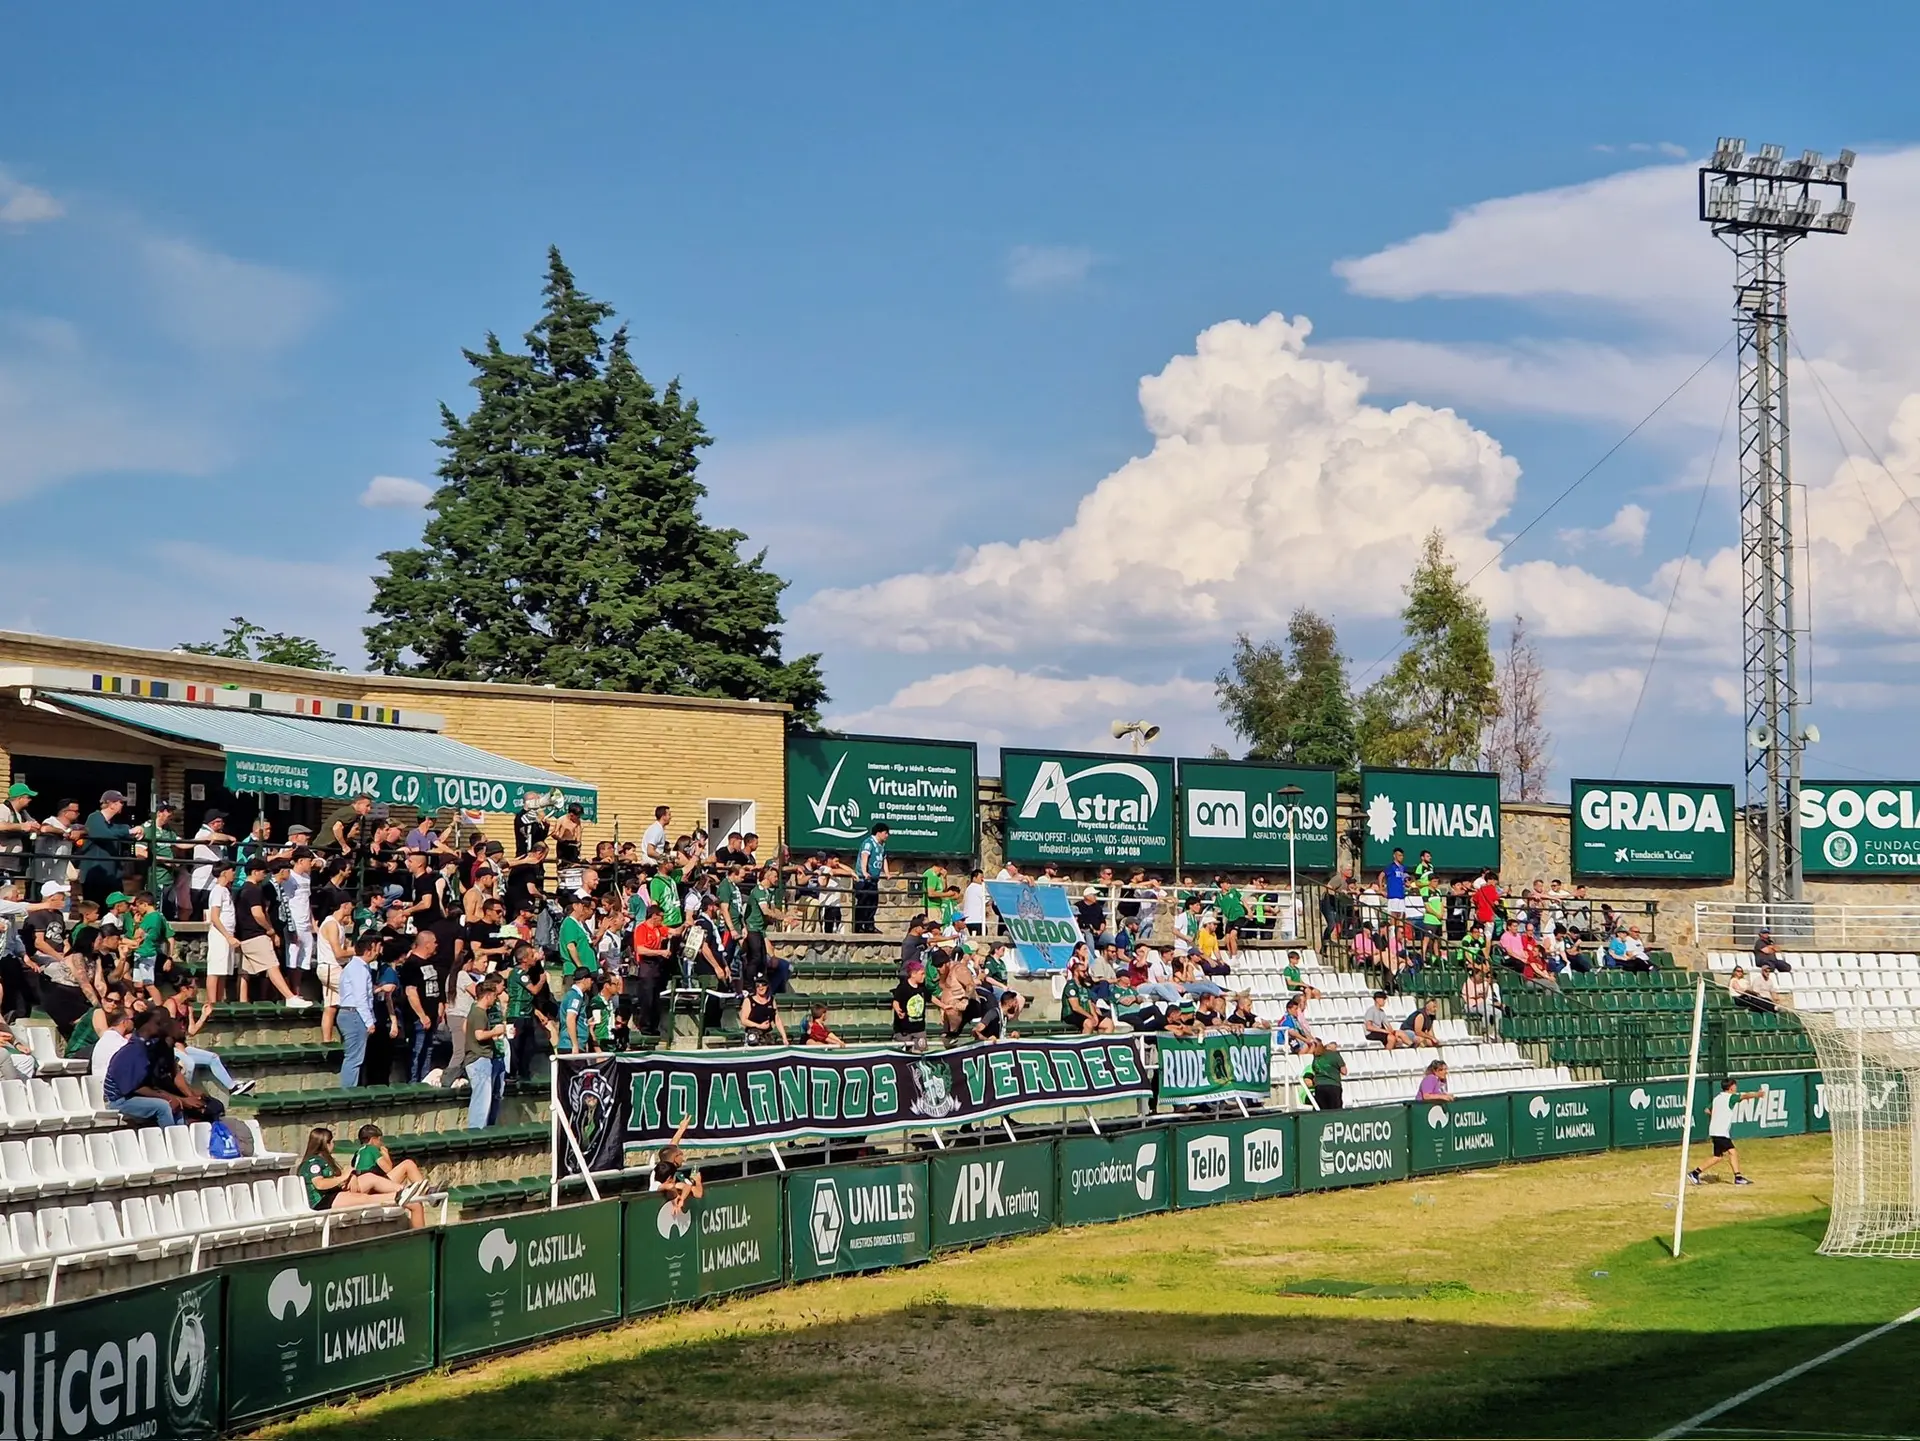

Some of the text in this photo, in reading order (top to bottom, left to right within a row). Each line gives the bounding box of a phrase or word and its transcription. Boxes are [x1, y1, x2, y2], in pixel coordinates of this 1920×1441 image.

[333, 768, 507, 809] BAR C.D. TOLEDO
[868, 777, 958, 799] VirtualTwin
[1019, 761, 1150, 823] Astral
[879, 802, 885, 810] El
[886, 803, 915, 811] Operador
[926, 804, 947, 812] Toledo
[886, 813, 917, 821] Empresas
[918, 814, 955, 823] Inteligentes
[1252, 793, 1329, 830] alonso
[1406, 801, 1495, 838] LIMASA
[1580, 789, 1726, 833] GRADA
[1799, 789, 1920, 829] SOCI
[1044, 832, 1067, 843] OFFSET
[1071, 833, 1091, 843] LONAS
[1094, 834, 1117, 844] VINILOS
[1121, 835, 1138, 845] GRAN
[1139, 836, 1166, 846] FORMATO
[1077, 821, 1108, 830] Proyectos
[1253, 832, 1277, 840] ASFALTO
[1282, 833, 1301, 841] OBAS
[1302, 832, 1328, 841] PÚBLICAS
[1039, 844, 1093, 856] info@astral-pg.com
[1104, 846, 1116, 855] 691
[1117, 846, 1128, 856] 204
[1630, 849, 1665, 859] Fundación
[1004, 917, 1077, 944] TOLEDO
[1162, 1045, 1268, 1088] RUDE BOYS
[626, 1062, 899, 1131] KOMANDOS
[962, 1045, 1142, 1106] VERDES
[1333, 1120, 1392, 1145] PACIFICO
[1556, 1122, 1595, 1140] LA MANCHA
[1656, 1117, 1665, 1130] LA
[1666, 1115, 1695, 1130] MANCA
[1248, 1140, 1279, 1172] Tello
[1454, 1133, 1494, 1151] LA MANCHA
[1072, 1157, 1132, 1195] grupoibérica
[1191, 1148, 1226, 1180] Tello
[1334, 1149, 1392, 1174] OCASION
[848, 1182, 915, 1225] UMILES
[949, 1160, 1039, 1225] APK renting
[702, 1239, 760, 1273] LA MANCHA
[527, 1272, 597, 1311] LA MANCHA
[324, 1317, 405, 1363] LA MANCHA
